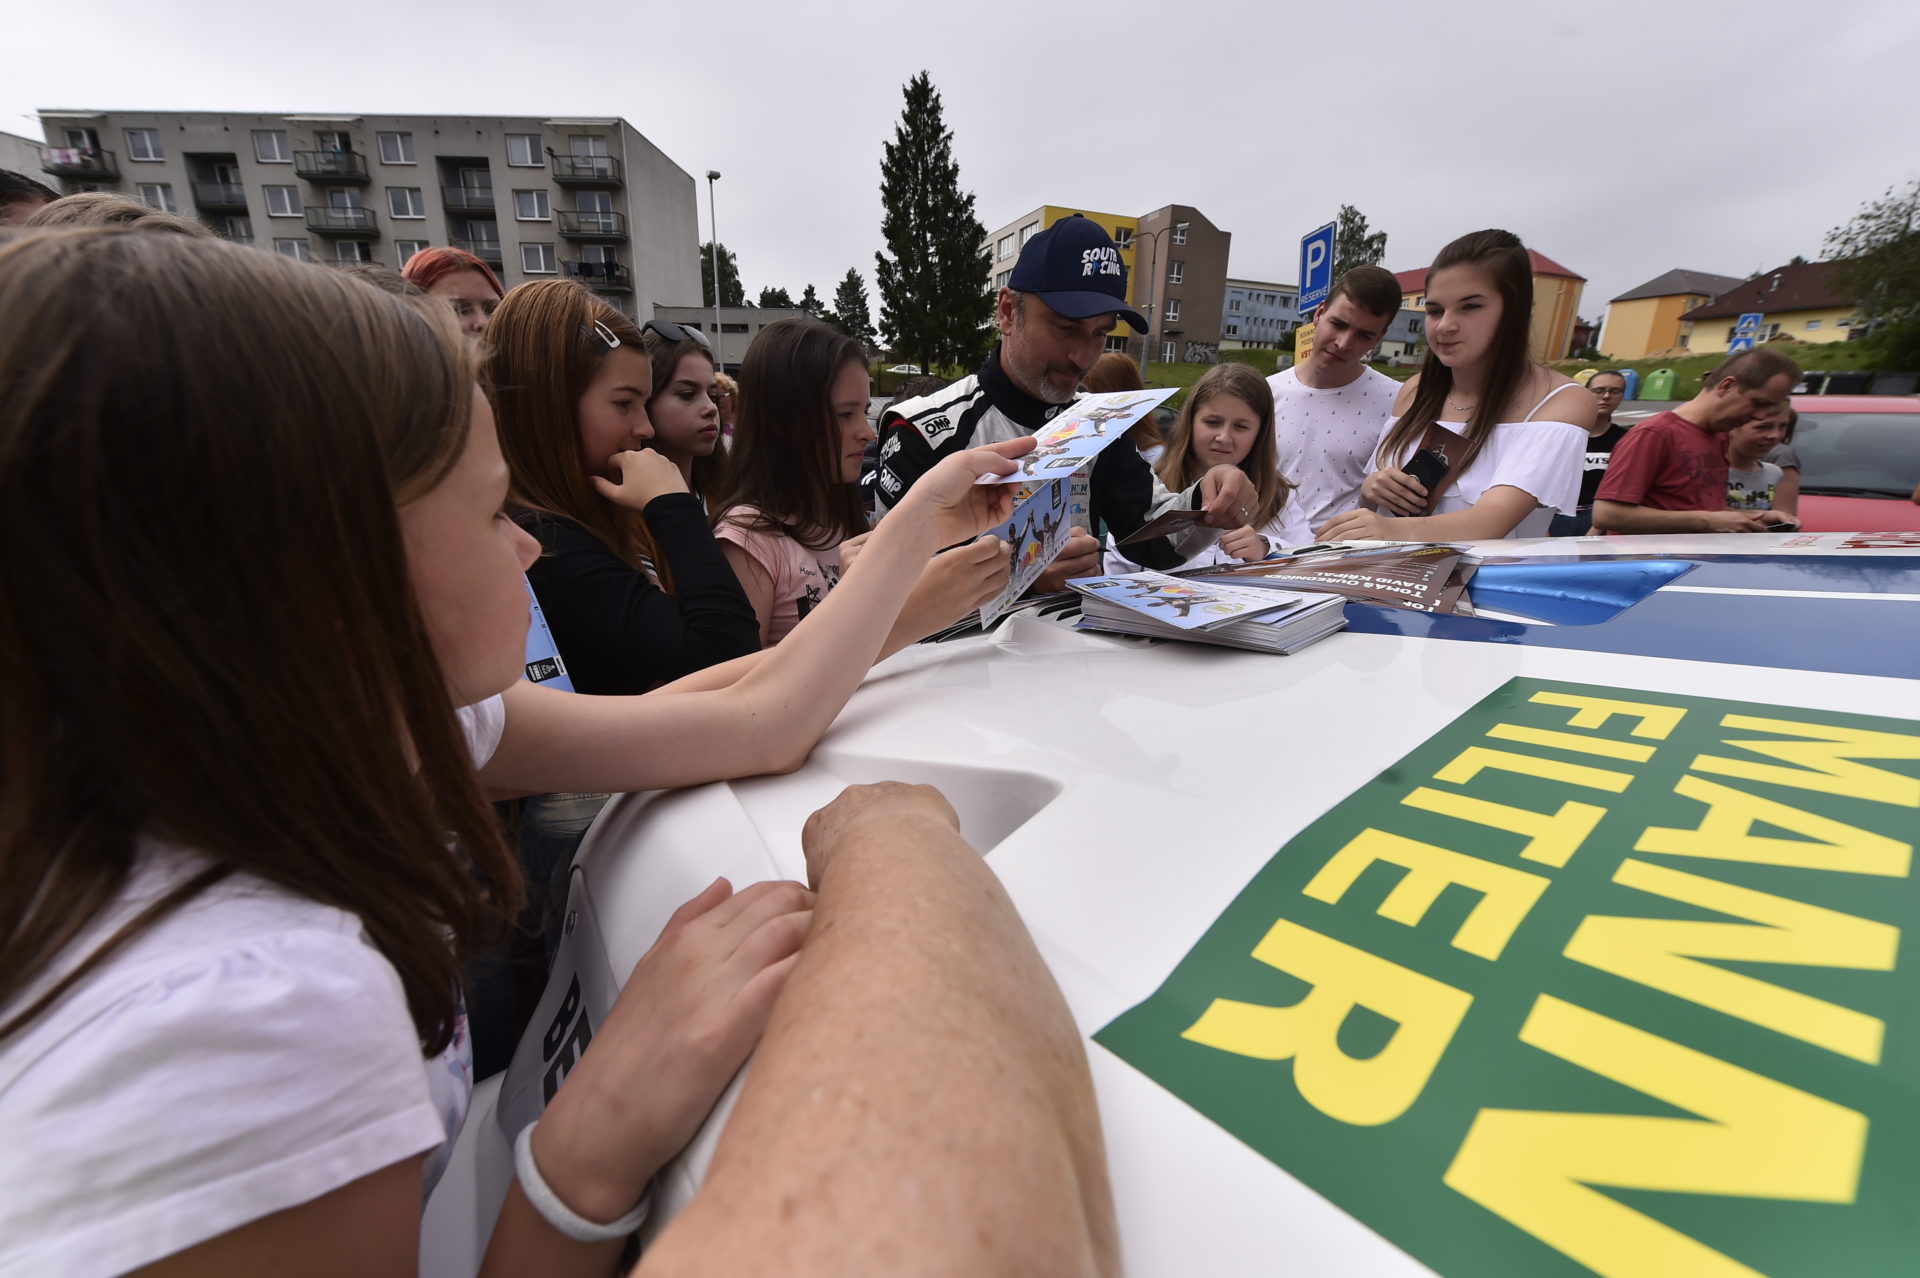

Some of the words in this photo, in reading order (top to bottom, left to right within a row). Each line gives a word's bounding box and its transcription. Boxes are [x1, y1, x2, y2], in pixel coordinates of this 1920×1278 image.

[1081, 246, 1118, 264] SOUTH
[1306, 239, 1326, 288] P
[924, 417, 951, 434] OMP
[881, 468, 902, 493] OMP
[1363, 582, 1423, 599] TOMÁŠ
[1375, 577, 1428, 592] DAVID
[1181, 691, 1688, 1126] FILTER
[1443, 713, 1920, 1278] MANN
